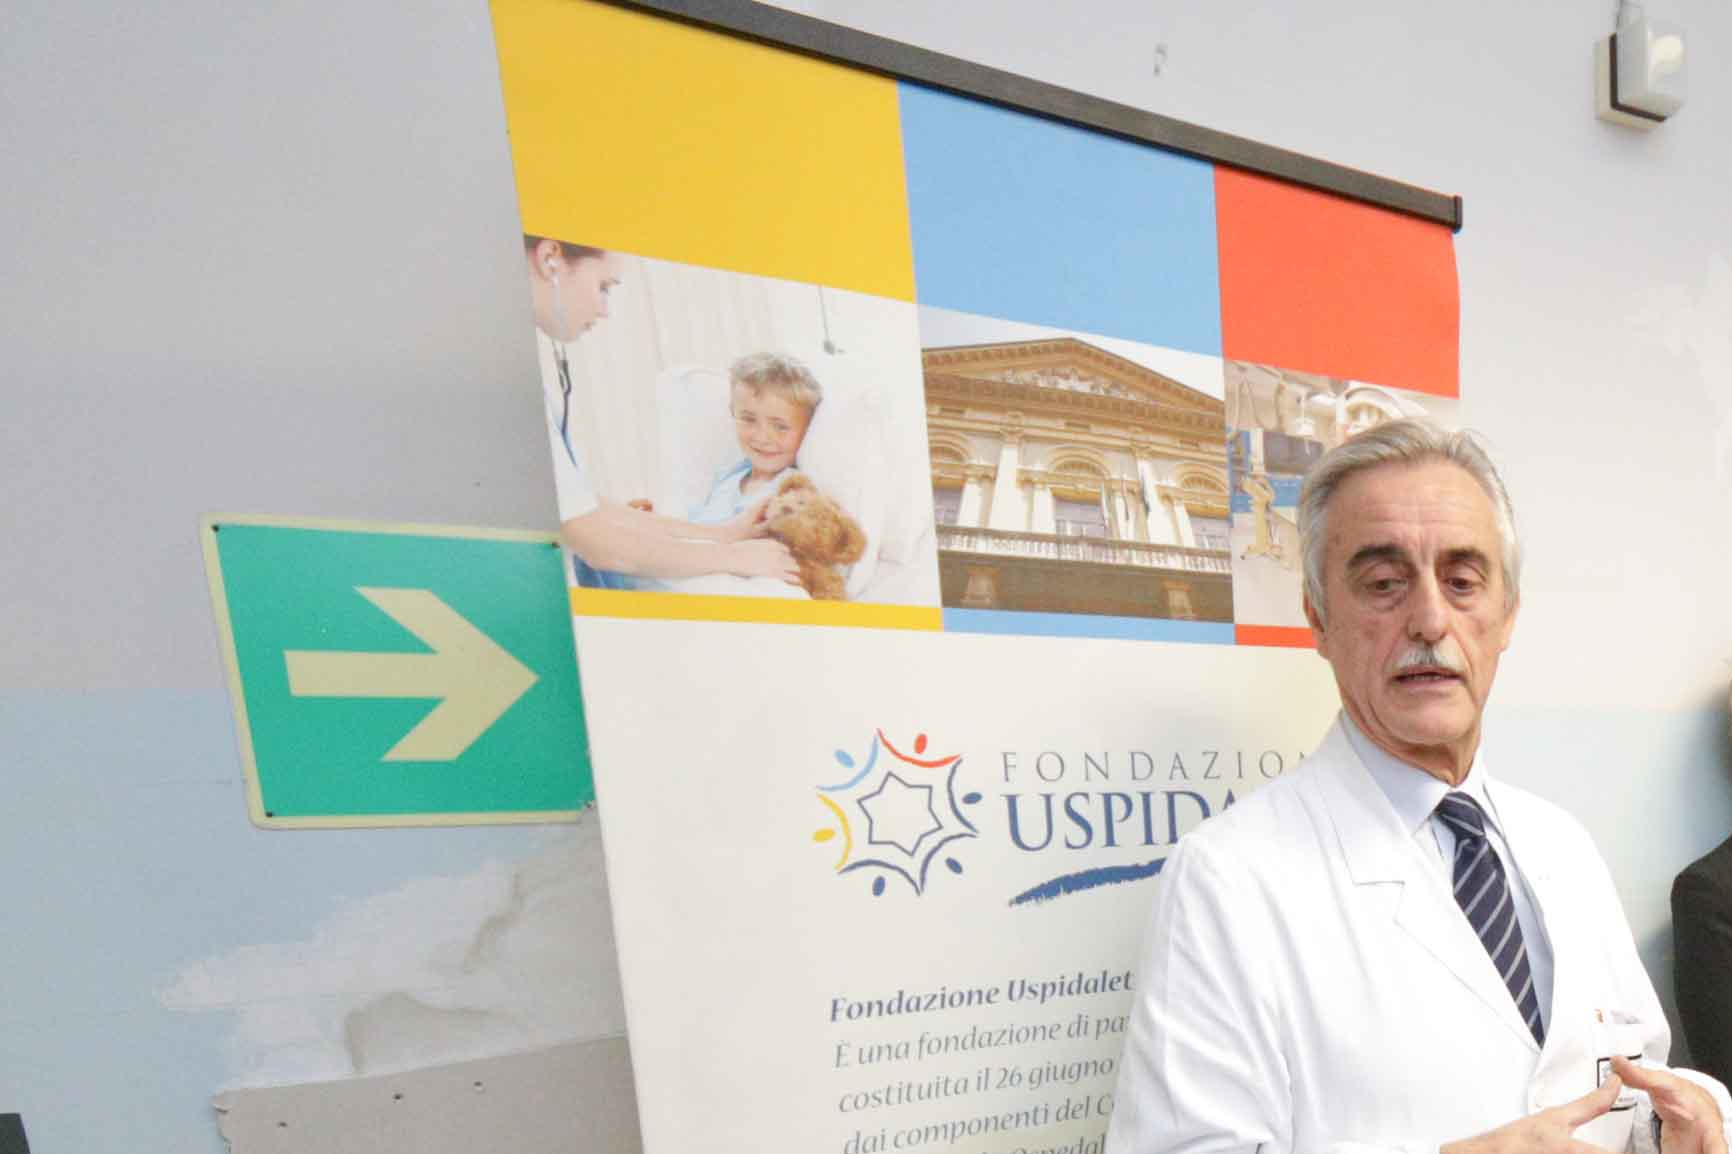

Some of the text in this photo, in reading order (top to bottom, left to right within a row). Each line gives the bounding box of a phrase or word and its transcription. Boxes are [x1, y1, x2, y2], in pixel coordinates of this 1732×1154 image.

[1001, 750, 1306, 783] FONDAZIO
[830, 986, 1000, 1023] Fondazione
[858, 1040, 910, 1066] una
[916, 1020, 1061, 1061] fondazione
[1067, 1013, 1089, 1038] di
[838, 1056, 1114, 1113] costituita il 26 giugno
[893, 1105, 1050, 1144] componenti
[1055, 1095, 1091, 1123] del
